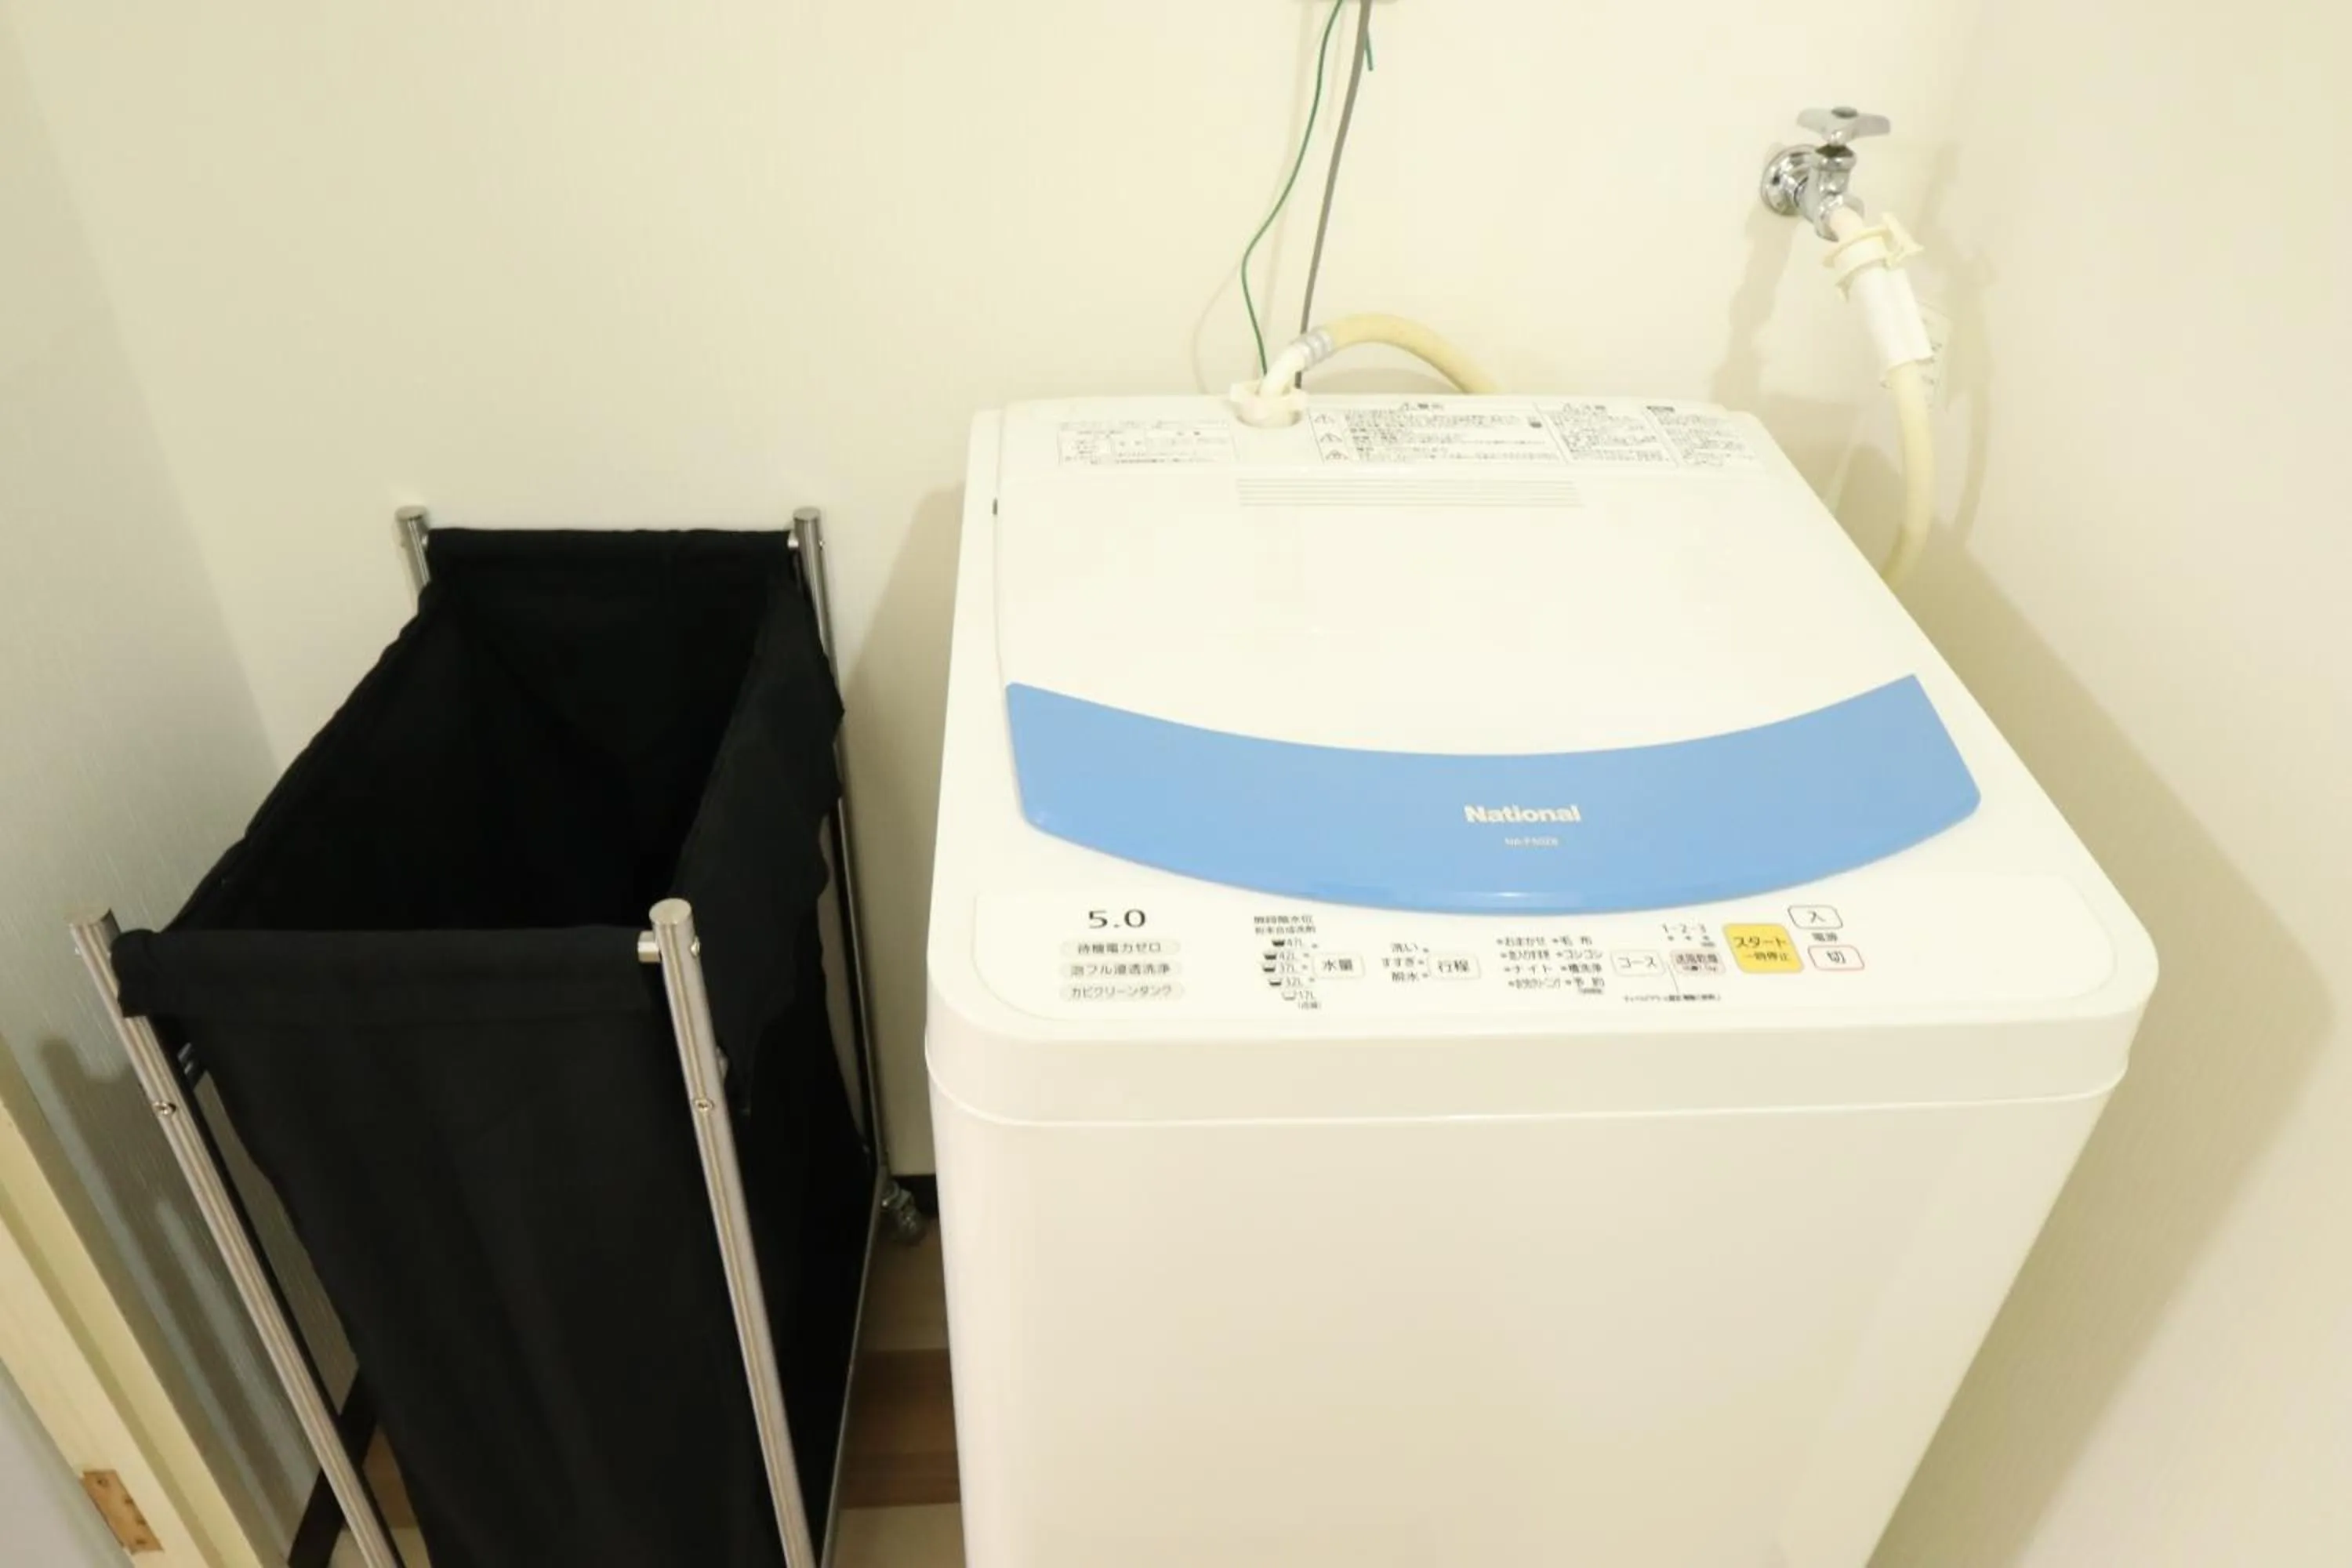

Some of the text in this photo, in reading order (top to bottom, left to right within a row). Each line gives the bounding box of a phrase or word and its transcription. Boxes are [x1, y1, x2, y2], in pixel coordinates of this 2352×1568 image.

[1463, 804, 1581, 823] National
[1087, 909, 1146, 929] 5.0
[1807, 909, 1826, 924] 入
[1077, 942, 1162, 955] 待機電力ゼロ
[1733, 935, 1788, 949] スタート
[1617, 954, 1658, 970] コース
[1825, 949, 1846, 965] 切
[1323, 958, 1353, 972] 水量
[1436, 959, 1471, 974] 行程
[1071, 985, 1174, 999] カビクリーンタンク
